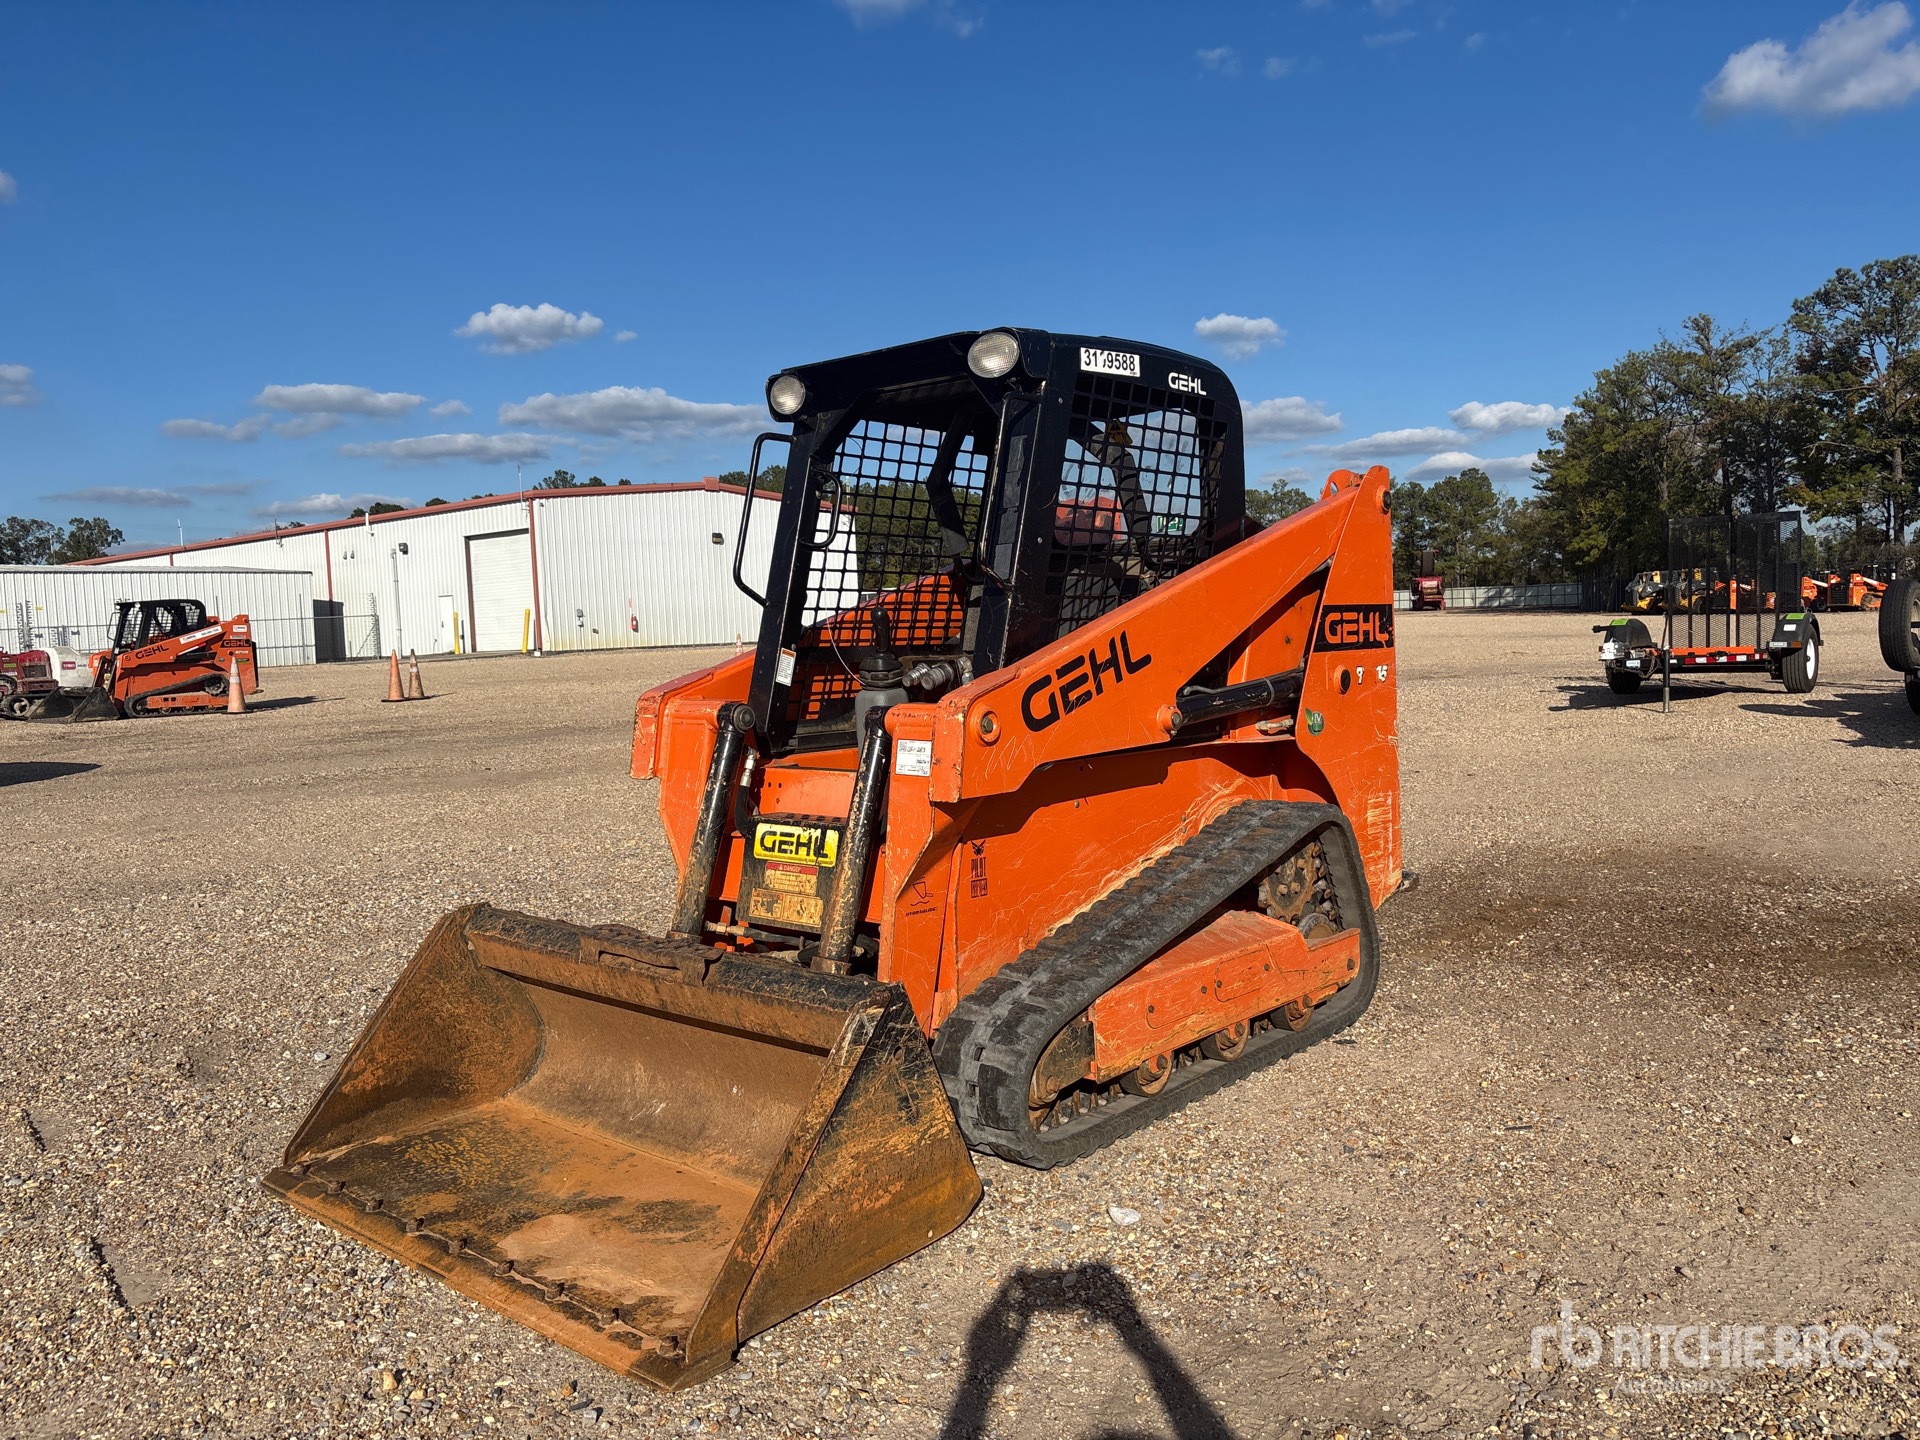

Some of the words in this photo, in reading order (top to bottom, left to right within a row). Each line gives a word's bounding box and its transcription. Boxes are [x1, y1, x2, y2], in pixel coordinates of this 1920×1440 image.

[1168, 372, 1207, 395] GEHL
[1325, 611, 1389, 644] GEHL
[135, 644, 169, 660] GEHL
[1021, 630, 1152, 732] GEHL
[760, 830, 828, 858] GEHL
[971, 857, 986, 878] PILOT
